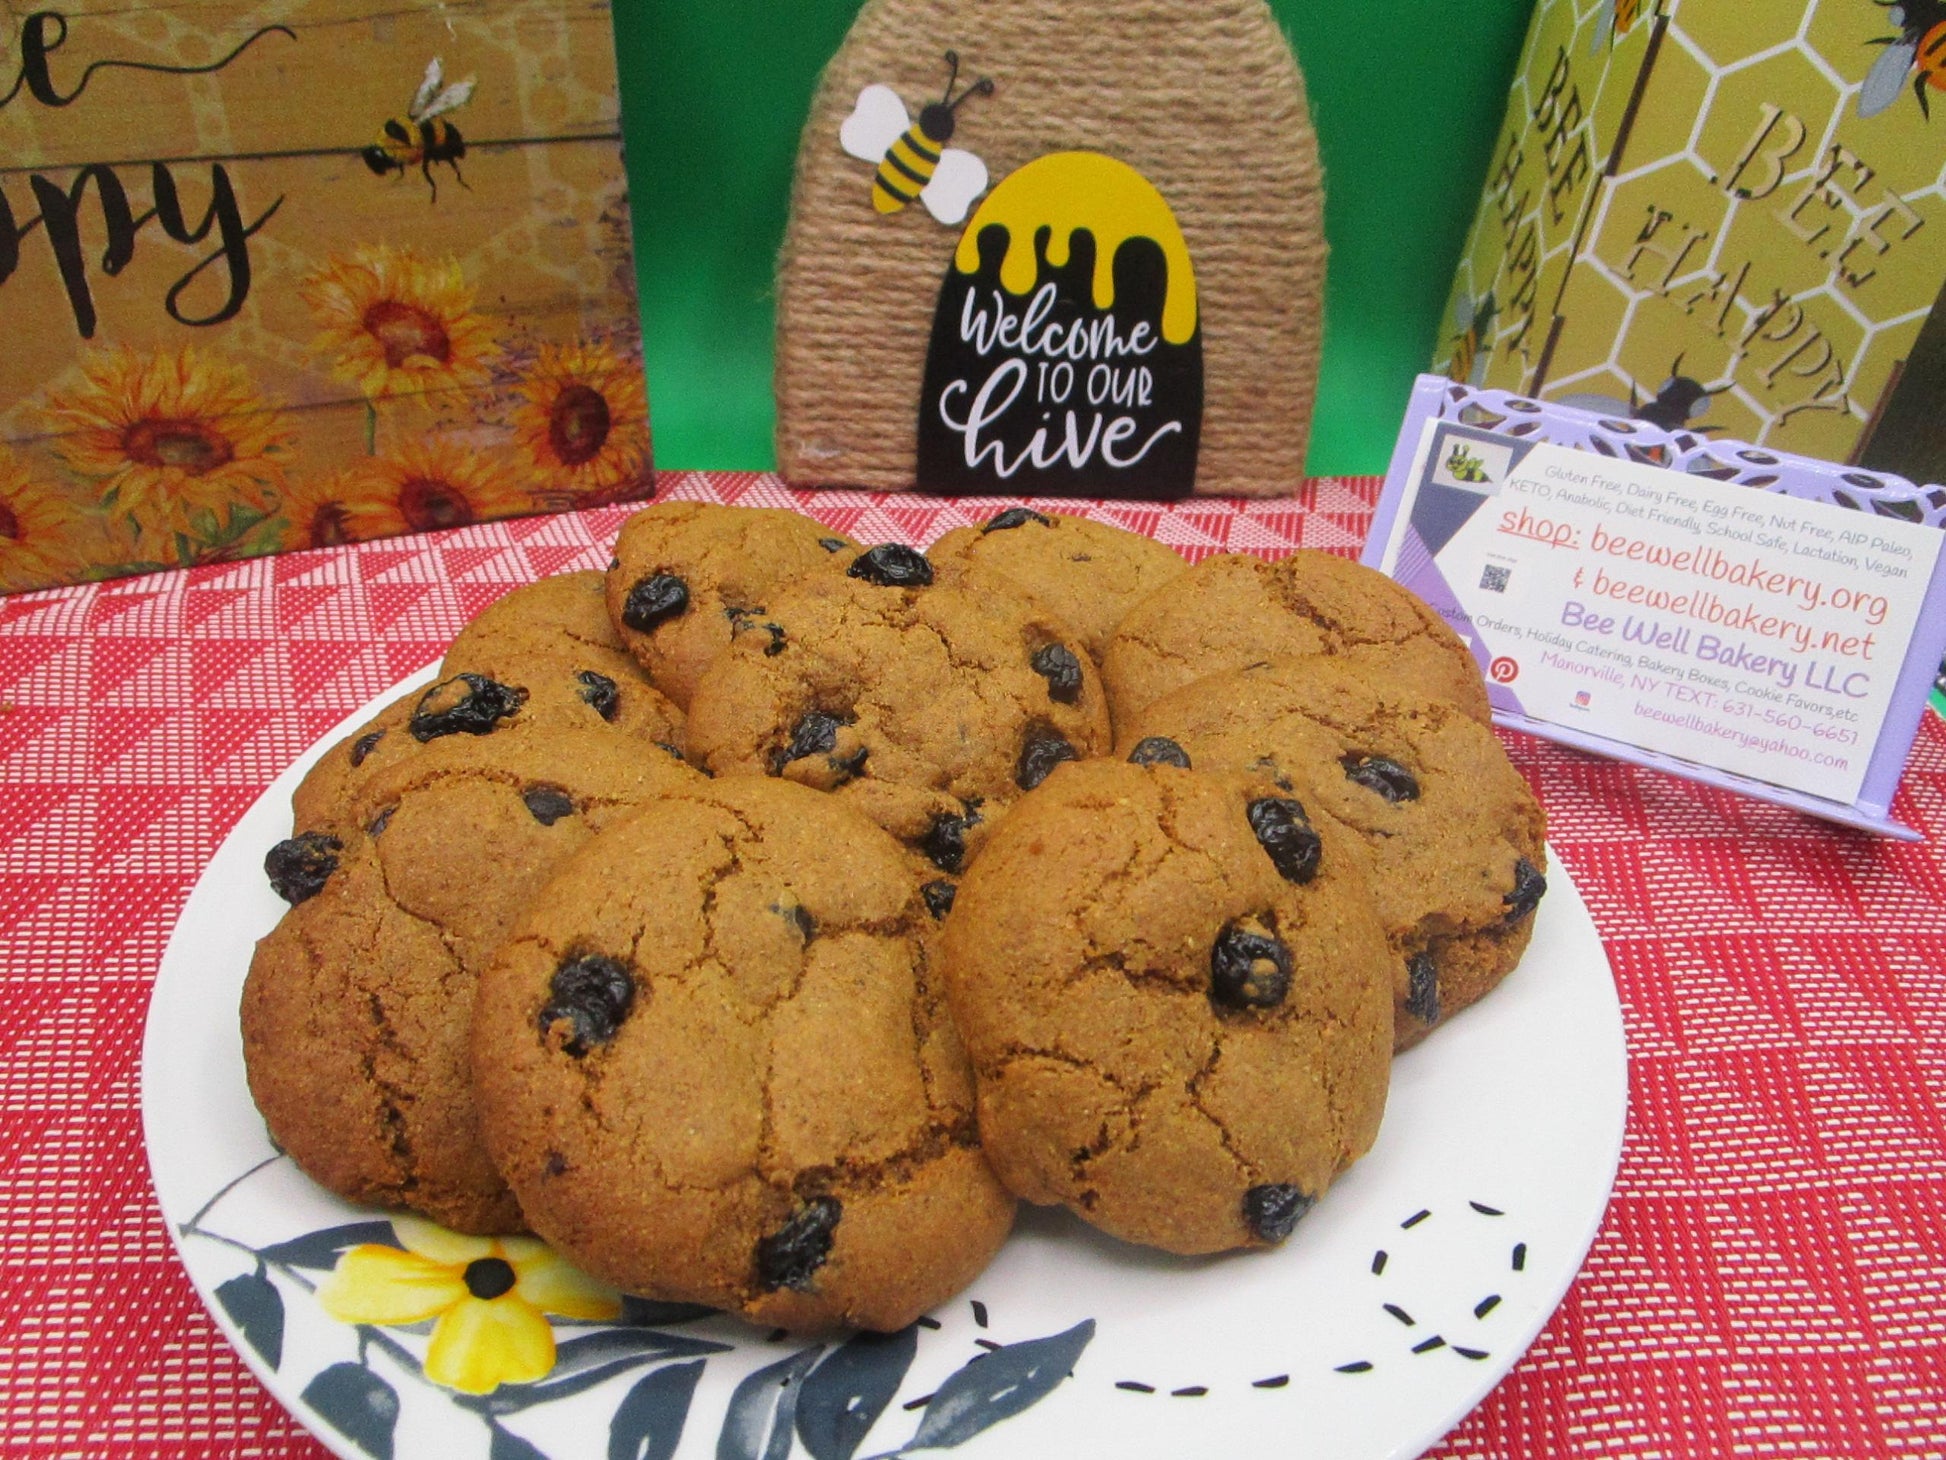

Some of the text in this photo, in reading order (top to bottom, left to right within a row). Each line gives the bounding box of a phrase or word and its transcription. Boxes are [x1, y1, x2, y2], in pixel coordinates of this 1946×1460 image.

[1533, 45, 1589, 227] BEE
[1722, 101, 1926, 288] BEE
[1493, 131, 1538, 364] HAPPY
[960, 282, 1158, 359] Welcome
[1609, 204, 1853, 427] HAPPY
[939, 358, 1182, 478] hive
[1037, 361, 1153, 408] TO OUR
[1509, 479, 1908, 579] KETO, Anabolic, Diet Friendly, School Safe, Lactation, Vegan
[1545, 465, 1588, 486] Gluten
[1591, 475, 1622, 496] Free,
[1627, 483, 1663, 502] Dairy
[1666, 491, 1699, 513] Free,
[1702, 500, 1728, 520] Egg
[1731, 506, 1766, 528] Free,
[1769, 515, 1796, 532] Nut
[1800, 521, 1834, 544] Free,
[1870, 537, 1914, 560] Paleo,
[1498, 506, 1889, 626] shop: beewellbakery.org
[1573, 567, 1877, 661] & beewellbakery.net
[1477, 615, 1523, 639] Orders,
[1527, 627, 1573, 651] Holiday
[1575, 640, 1633, 668] Catering,
[1638, 655, 1686, 681] Bakery
[1688, 668, 1731, 694] Boxes,
[1734, 681, 1783, 705] Cookie
[1540, 651, 1859, 746] Manorville, NY TEXT: 631-560-6651
[1560, 601, 1871, 699] Bee Well Bakery LLC
[1634, 701, 1849, 770] beewellbakery@yahoo.com
